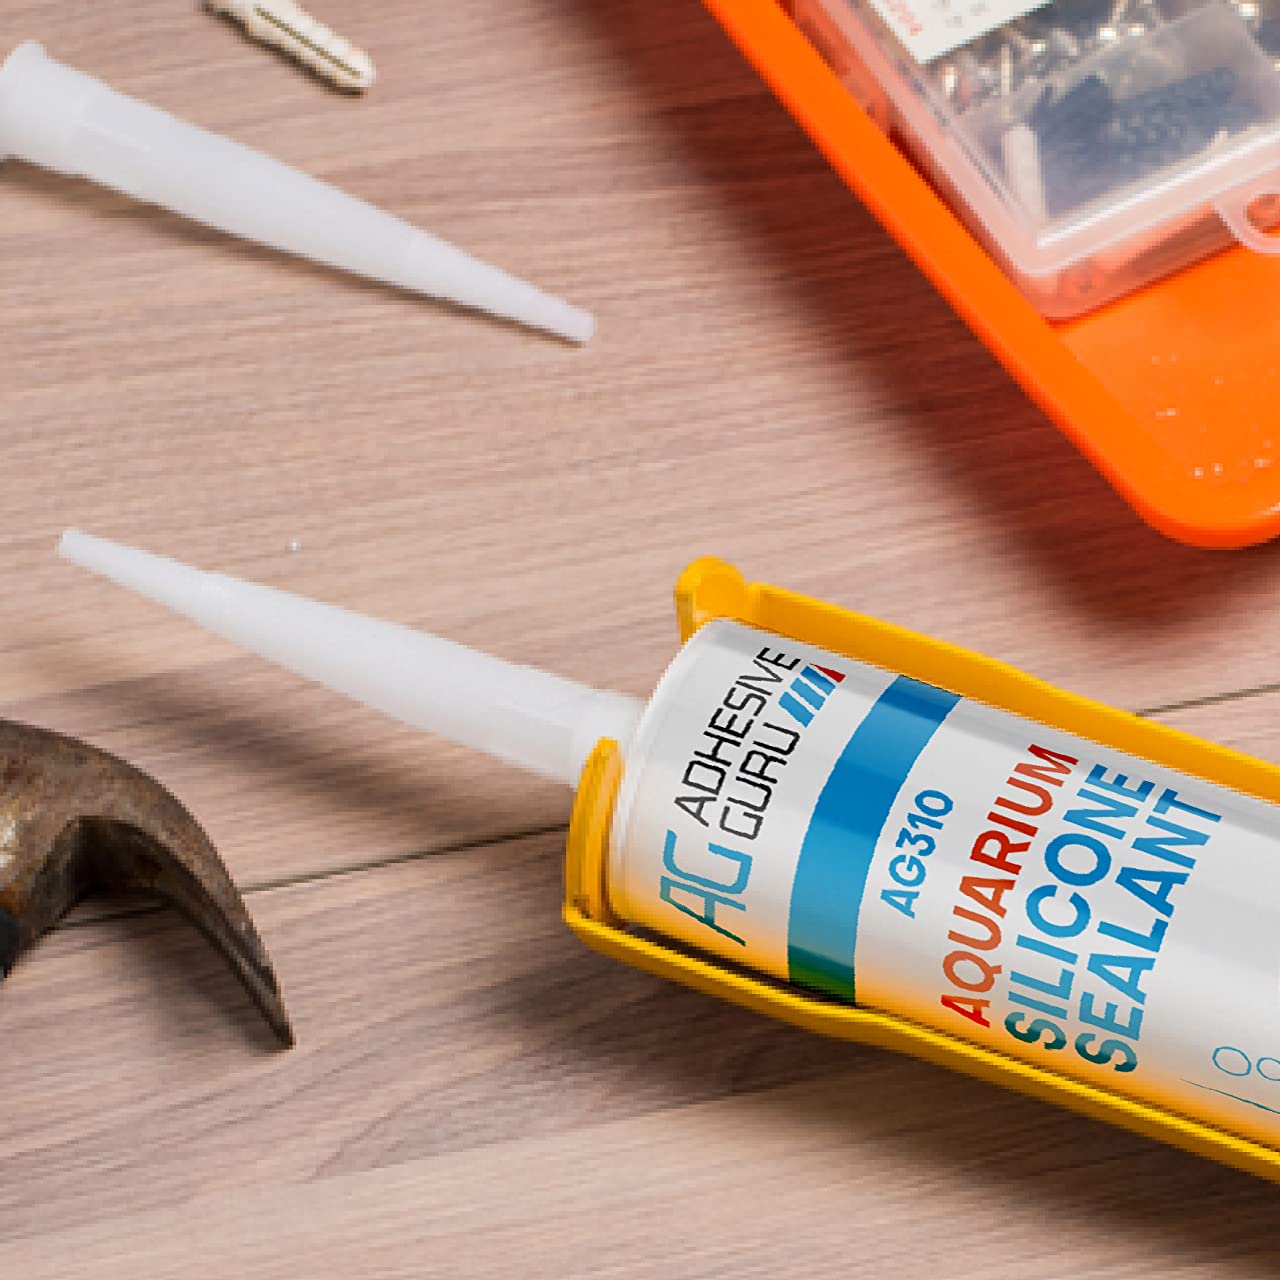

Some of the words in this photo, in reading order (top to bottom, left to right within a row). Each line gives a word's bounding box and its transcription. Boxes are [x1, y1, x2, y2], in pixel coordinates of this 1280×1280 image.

[674, 647, 801, 827] ADHESIVE
[719, 722, 801, 840] GURU
[660, 829, 752, 947] AG
[881, 790, 953, 918] AG310
[941, 744, 1079, 1028] AQUARIUM
[1004, 764, 1156, 1050] SILICONE
[1074, 789, 1222, 1073] SEALANT
